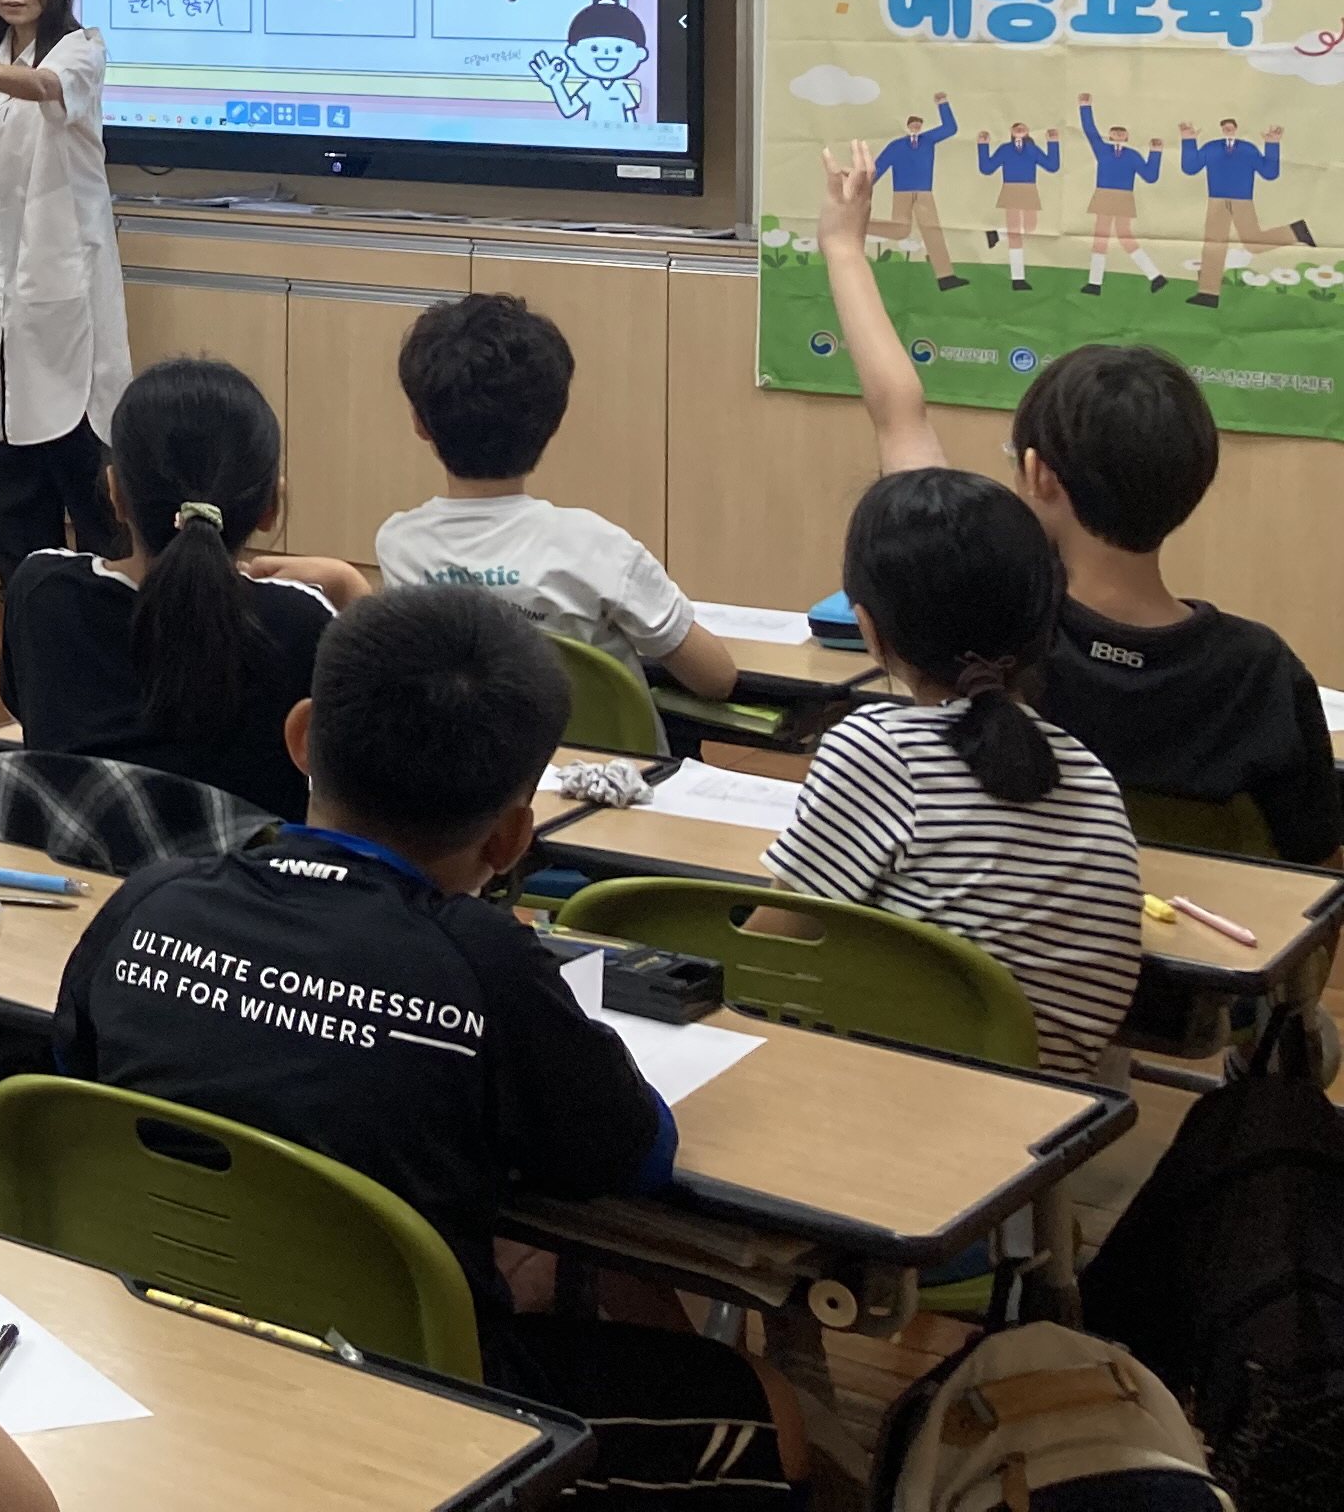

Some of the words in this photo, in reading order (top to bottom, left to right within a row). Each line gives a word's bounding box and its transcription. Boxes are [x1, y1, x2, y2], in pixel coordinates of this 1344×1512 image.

[1188, 364, 1334, 393] 청소년상담복지센터
[115, 958, 167, 994] GEAR
[176, 976, 229, 1012] FOR
[239, 994, 377, 1049] WINNERS
[130, 928, 253, 983] ULTIMATE
[258, 966, 486, 1038] COMPRESSION
